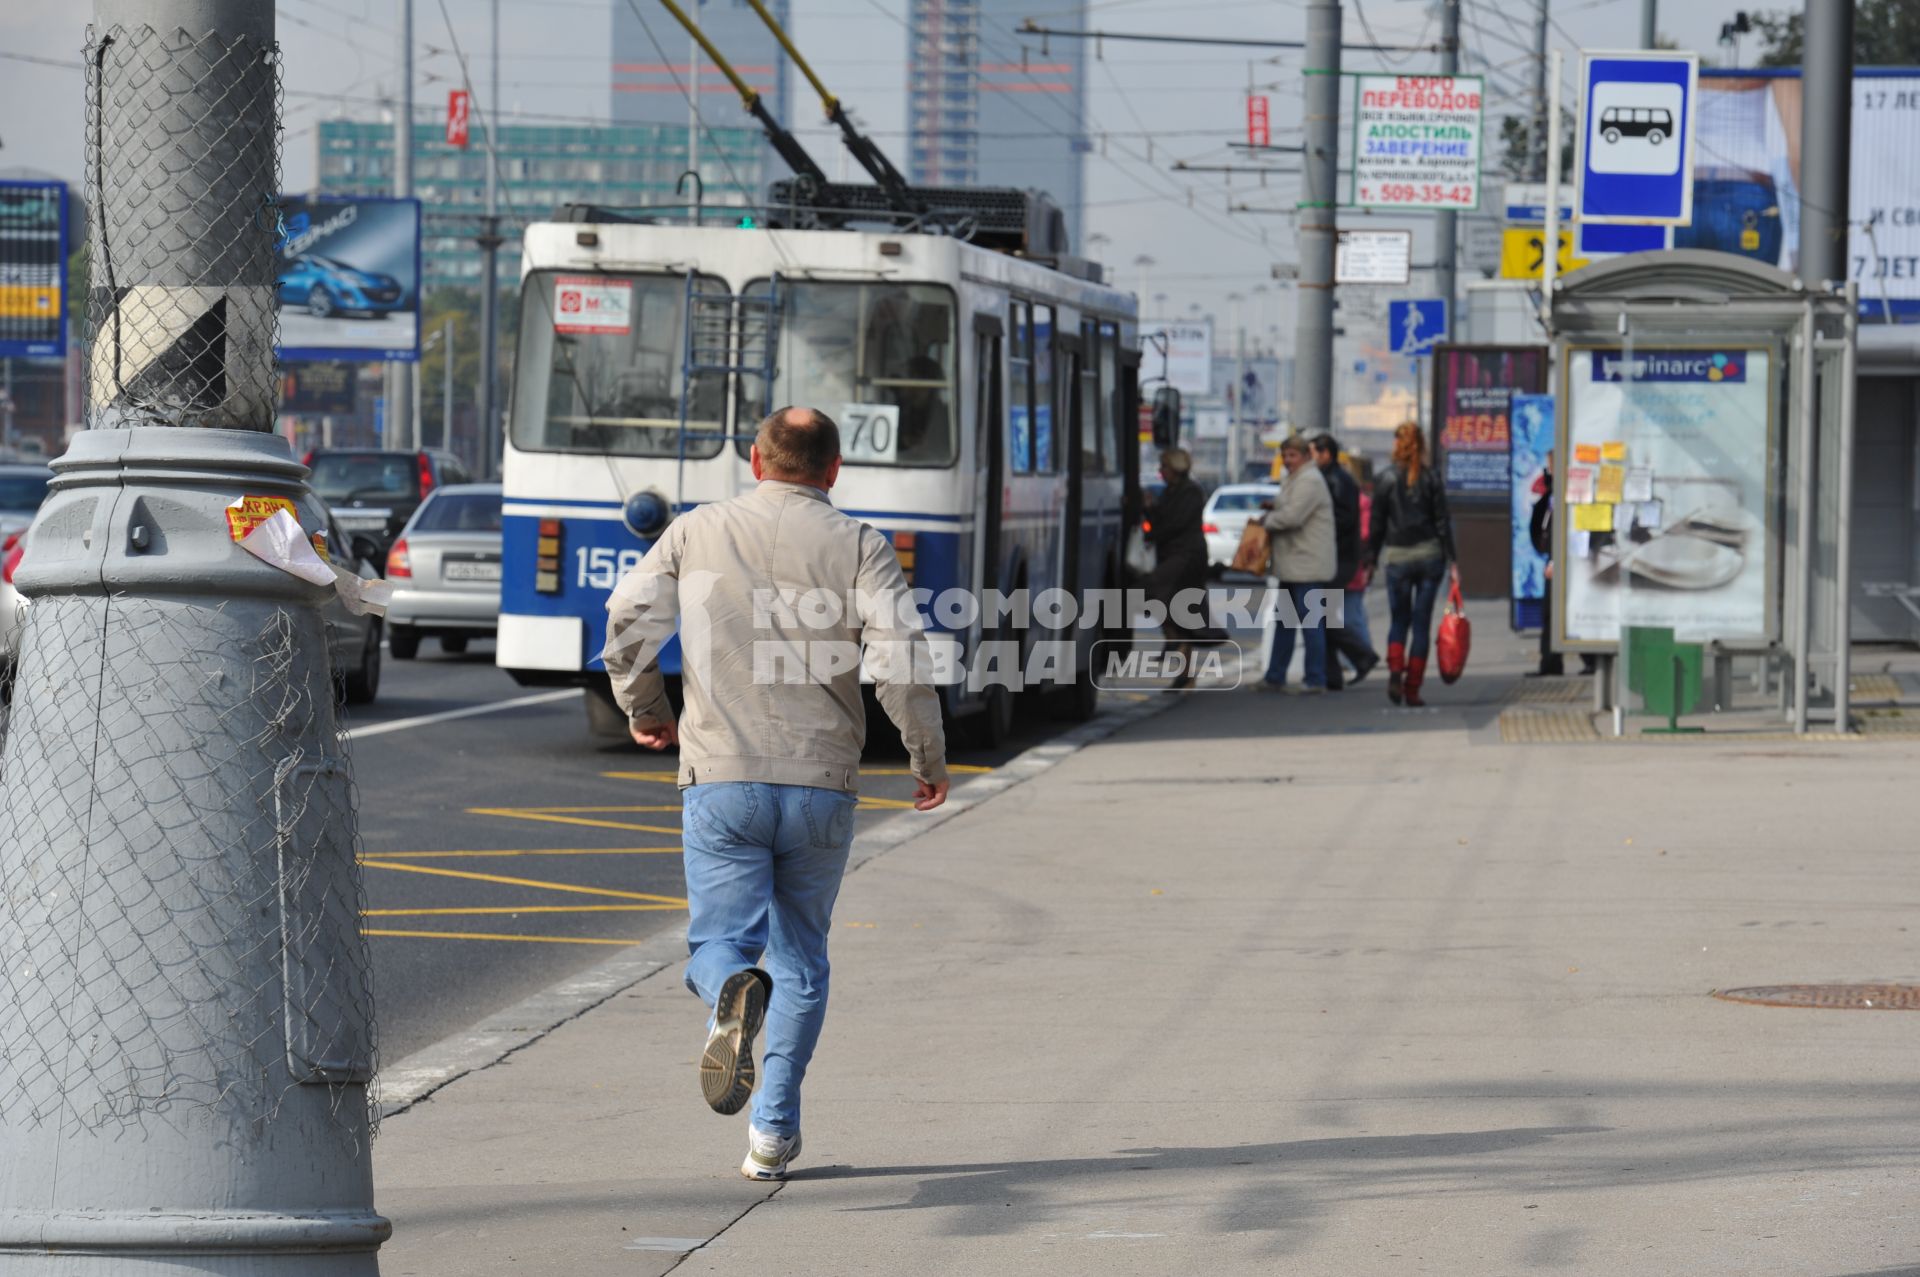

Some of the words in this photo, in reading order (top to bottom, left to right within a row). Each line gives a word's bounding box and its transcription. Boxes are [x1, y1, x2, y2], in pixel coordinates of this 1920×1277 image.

[1396, 75, 1455, 91] БЮРО
[1363, 91, 1481, 111] ПЕРЕВОДОВ
[1865, 91, 1887, 110] 17
[1368, 124, 1473, 140] АПОСТИЛЬ
[1366, 140, 1469, 157] ЗАВЕРЕНИЕ
[1381, 183, 1472, 204] 509-35-42
[1873, 256, 1919, 278] ЛЕТ
[848, 414, 891, 453] 70
[234, 500, 286, 513] ХРАН
